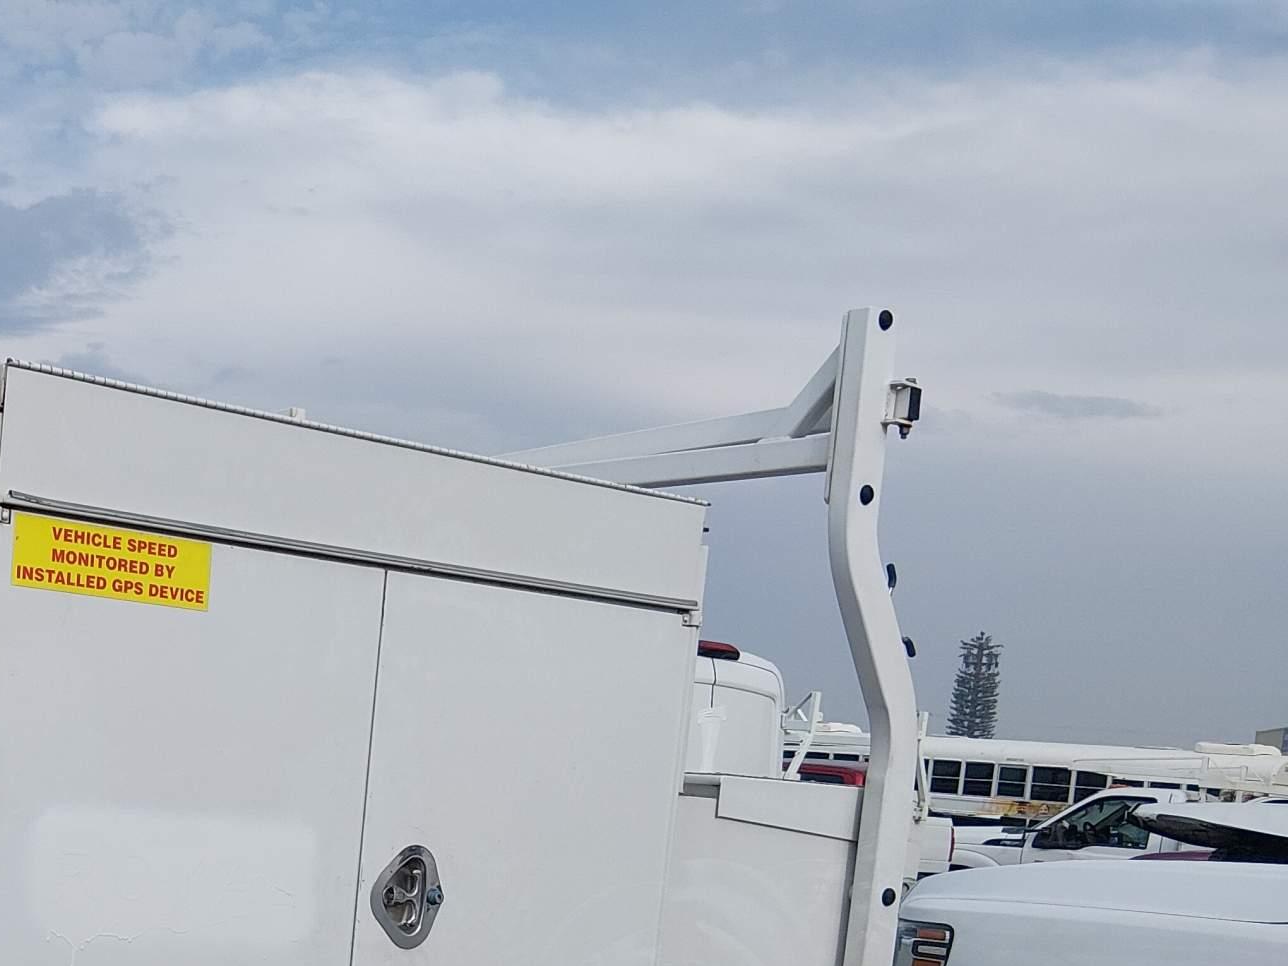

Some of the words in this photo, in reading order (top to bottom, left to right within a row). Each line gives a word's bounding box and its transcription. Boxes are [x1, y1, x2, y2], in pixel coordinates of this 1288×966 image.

[52, 526, 122, 550] VEHICLE
[127, 538, 178, 558] SPEED
[51, 548, 150, 575] MONITORED
[154, 563, 175, 579] BY
[16, 565, 107, 590] INSTALLED
[112, 578, 144, 596] GPS
[149, 583, 205, 604] DEVICE
